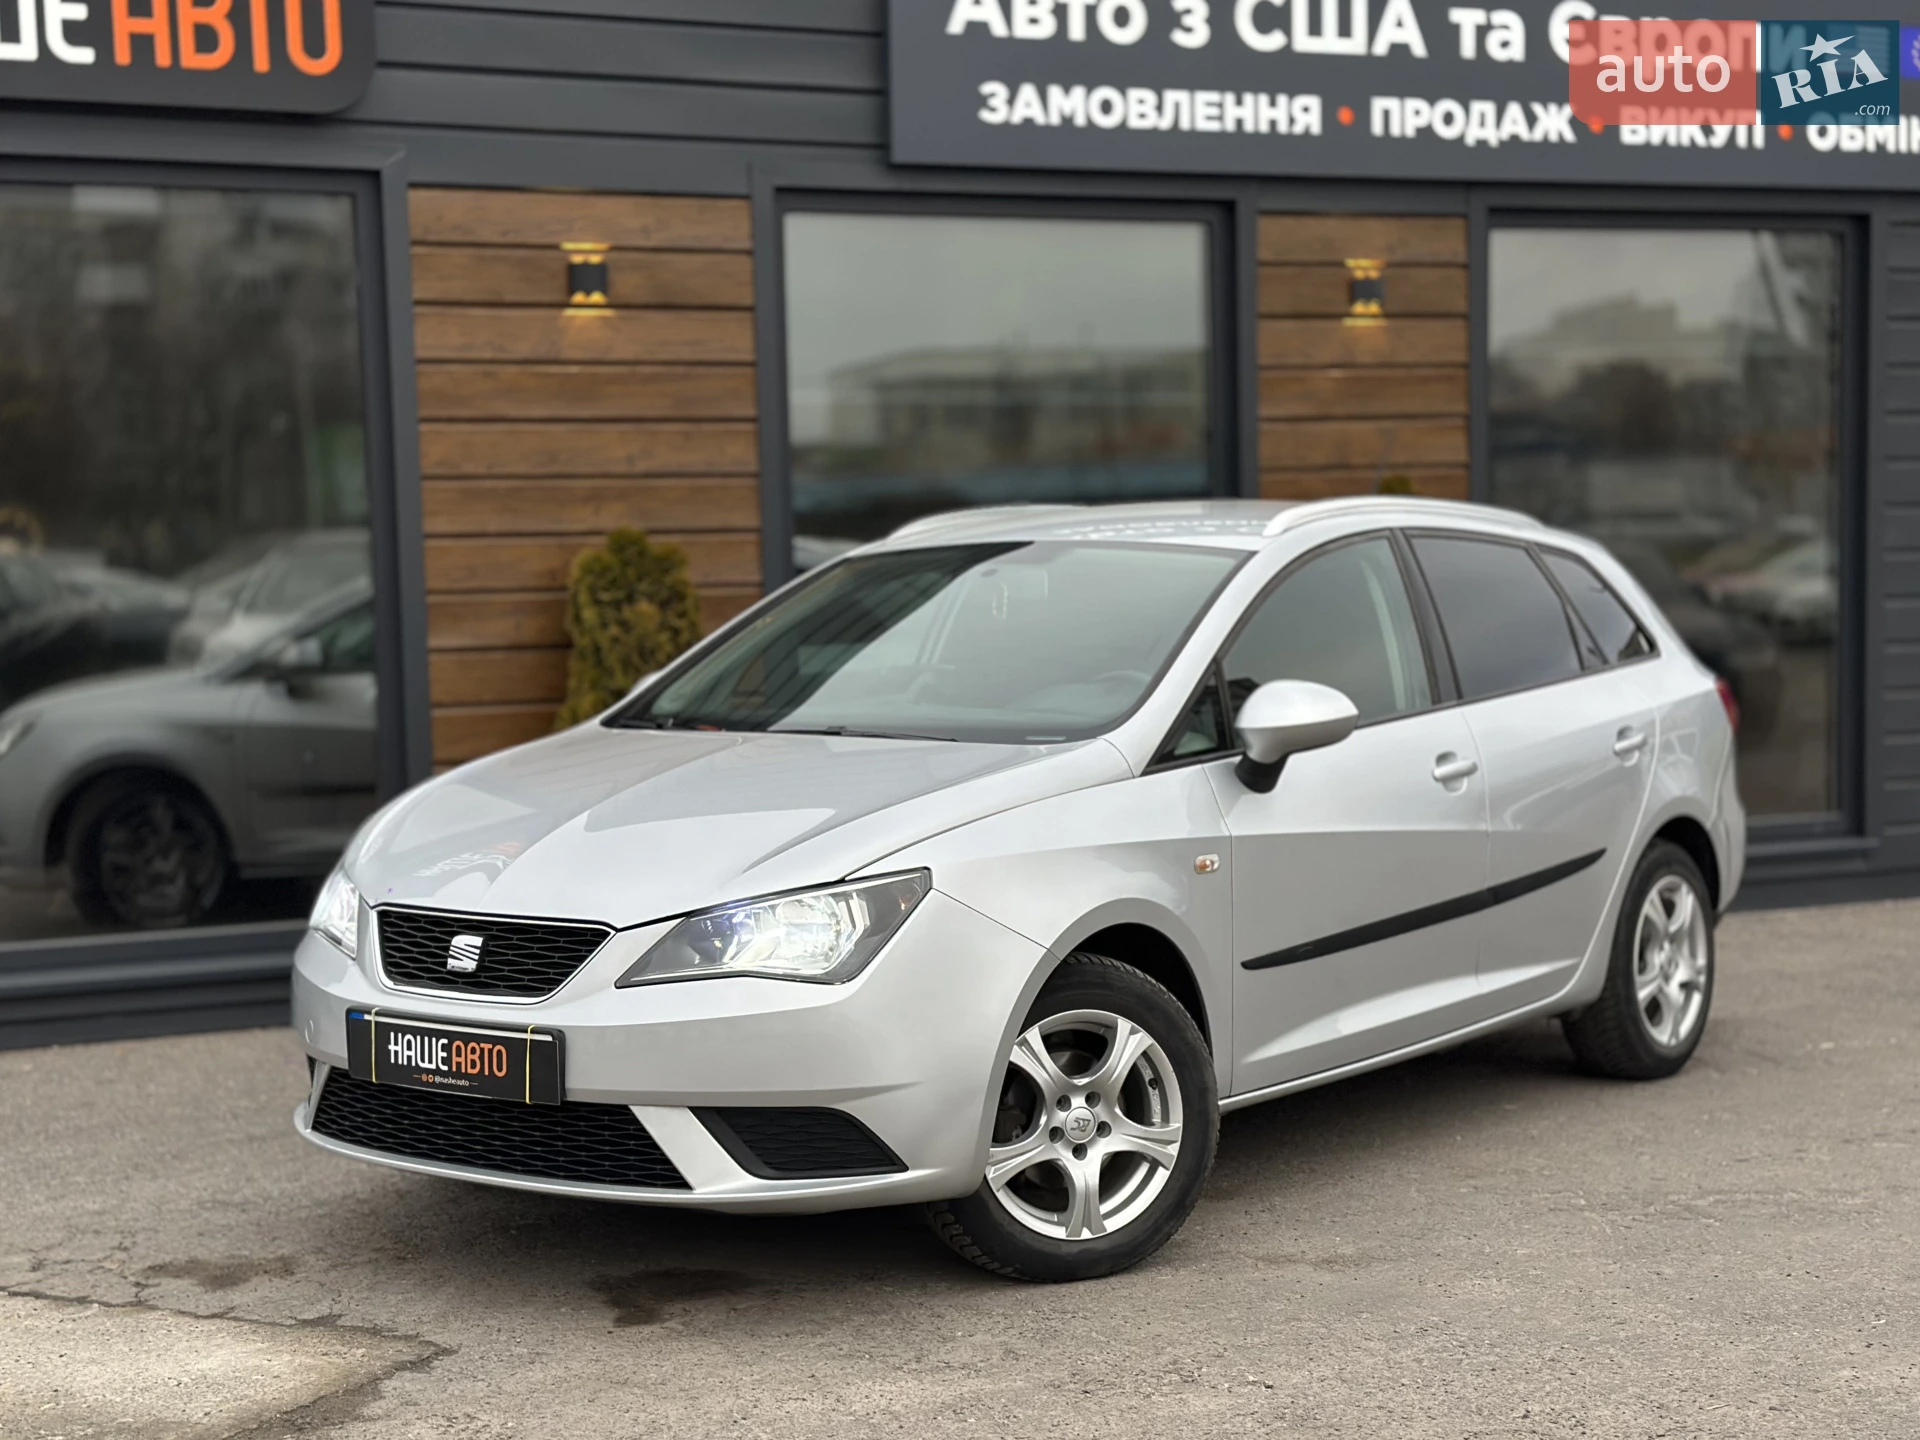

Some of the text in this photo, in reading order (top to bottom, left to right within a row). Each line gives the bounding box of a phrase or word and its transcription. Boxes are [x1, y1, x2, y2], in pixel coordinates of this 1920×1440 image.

[1234, 0, 1429, 57] США
[1449, 7, 1526, 62] та
[978, 81, 1322, 135] ЗАМОВЛЕННЯ
[1370, 96, 1577, 147] ПРОДАЖ
[1619, 105, 1765, 149] ВИКУП
